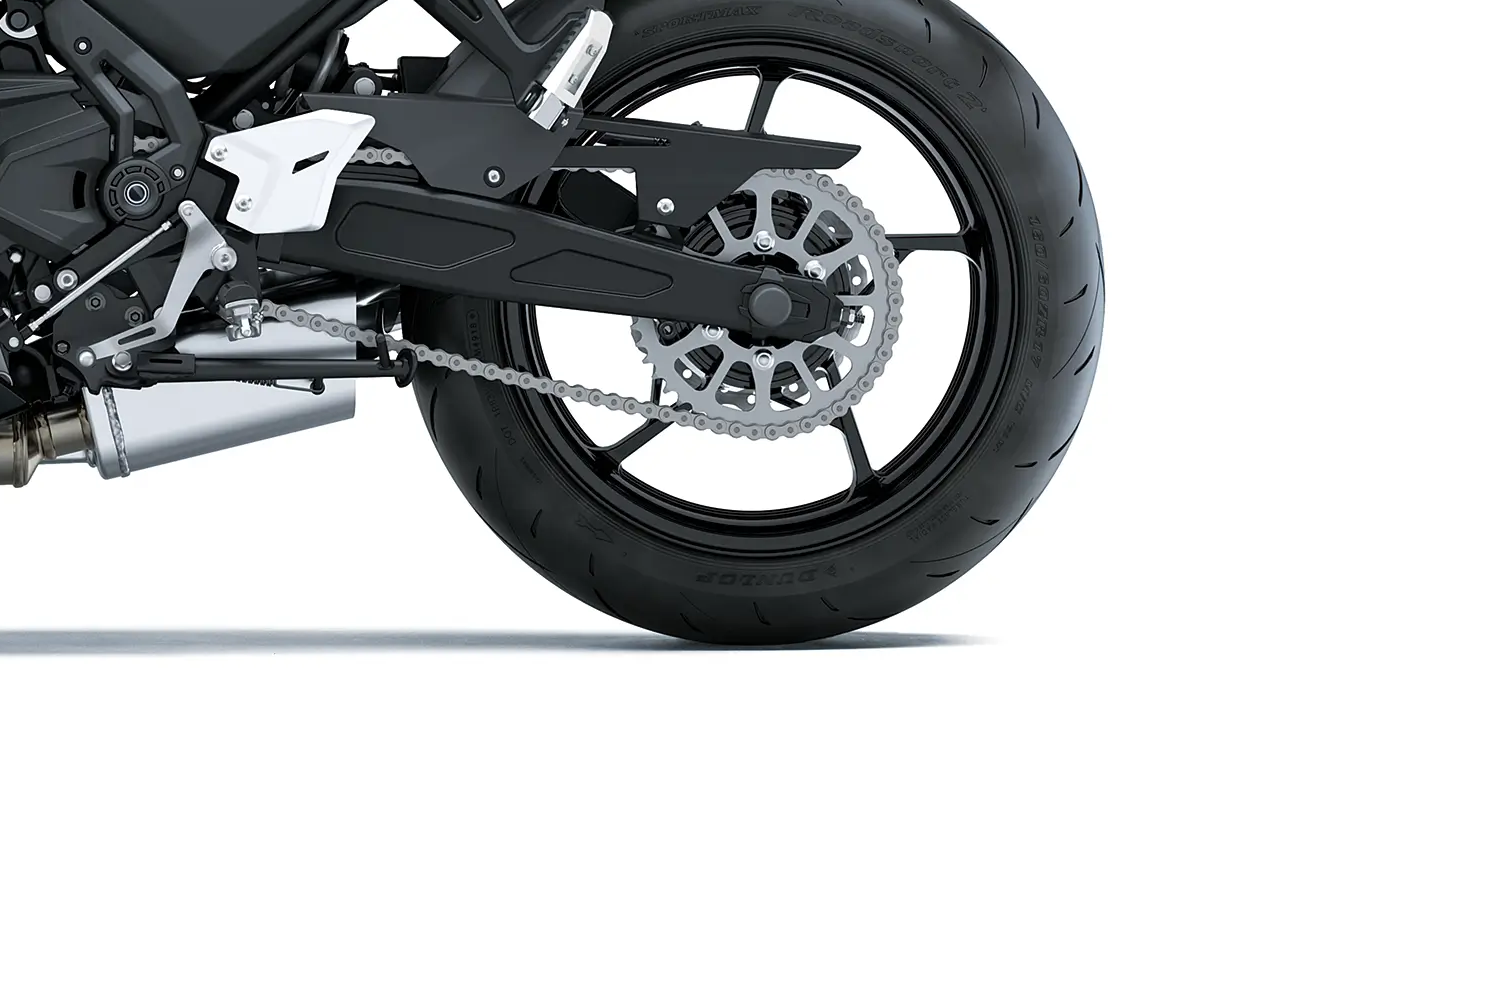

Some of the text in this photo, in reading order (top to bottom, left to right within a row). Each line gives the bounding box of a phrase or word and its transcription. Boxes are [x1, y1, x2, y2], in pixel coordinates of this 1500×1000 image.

[790, 5, 961, 90] Roadsport
[500, 424, 517, 446] DOT
[695, 567, 819, 588] DUNLOP
